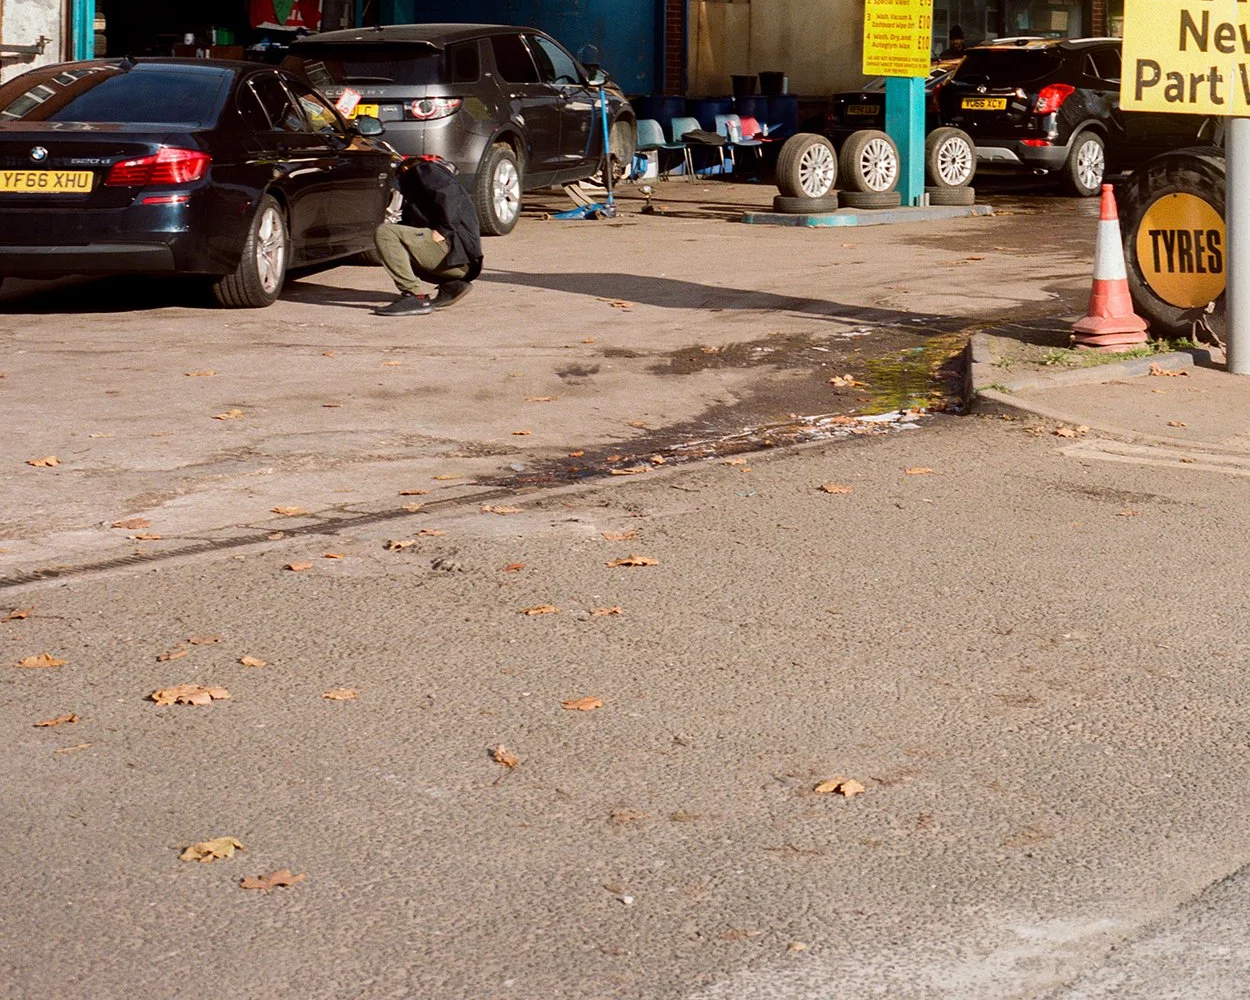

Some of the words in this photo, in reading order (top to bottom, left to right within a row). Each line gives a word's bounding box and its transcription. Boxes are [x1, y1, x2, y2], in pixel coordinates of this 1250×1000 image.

[1134, 58, 1224, 106] Part
[3, 173, 47, 188] YF66
[53, 173, 89, 188] XHU
[1148, 229, 1223, 274] TYRES
